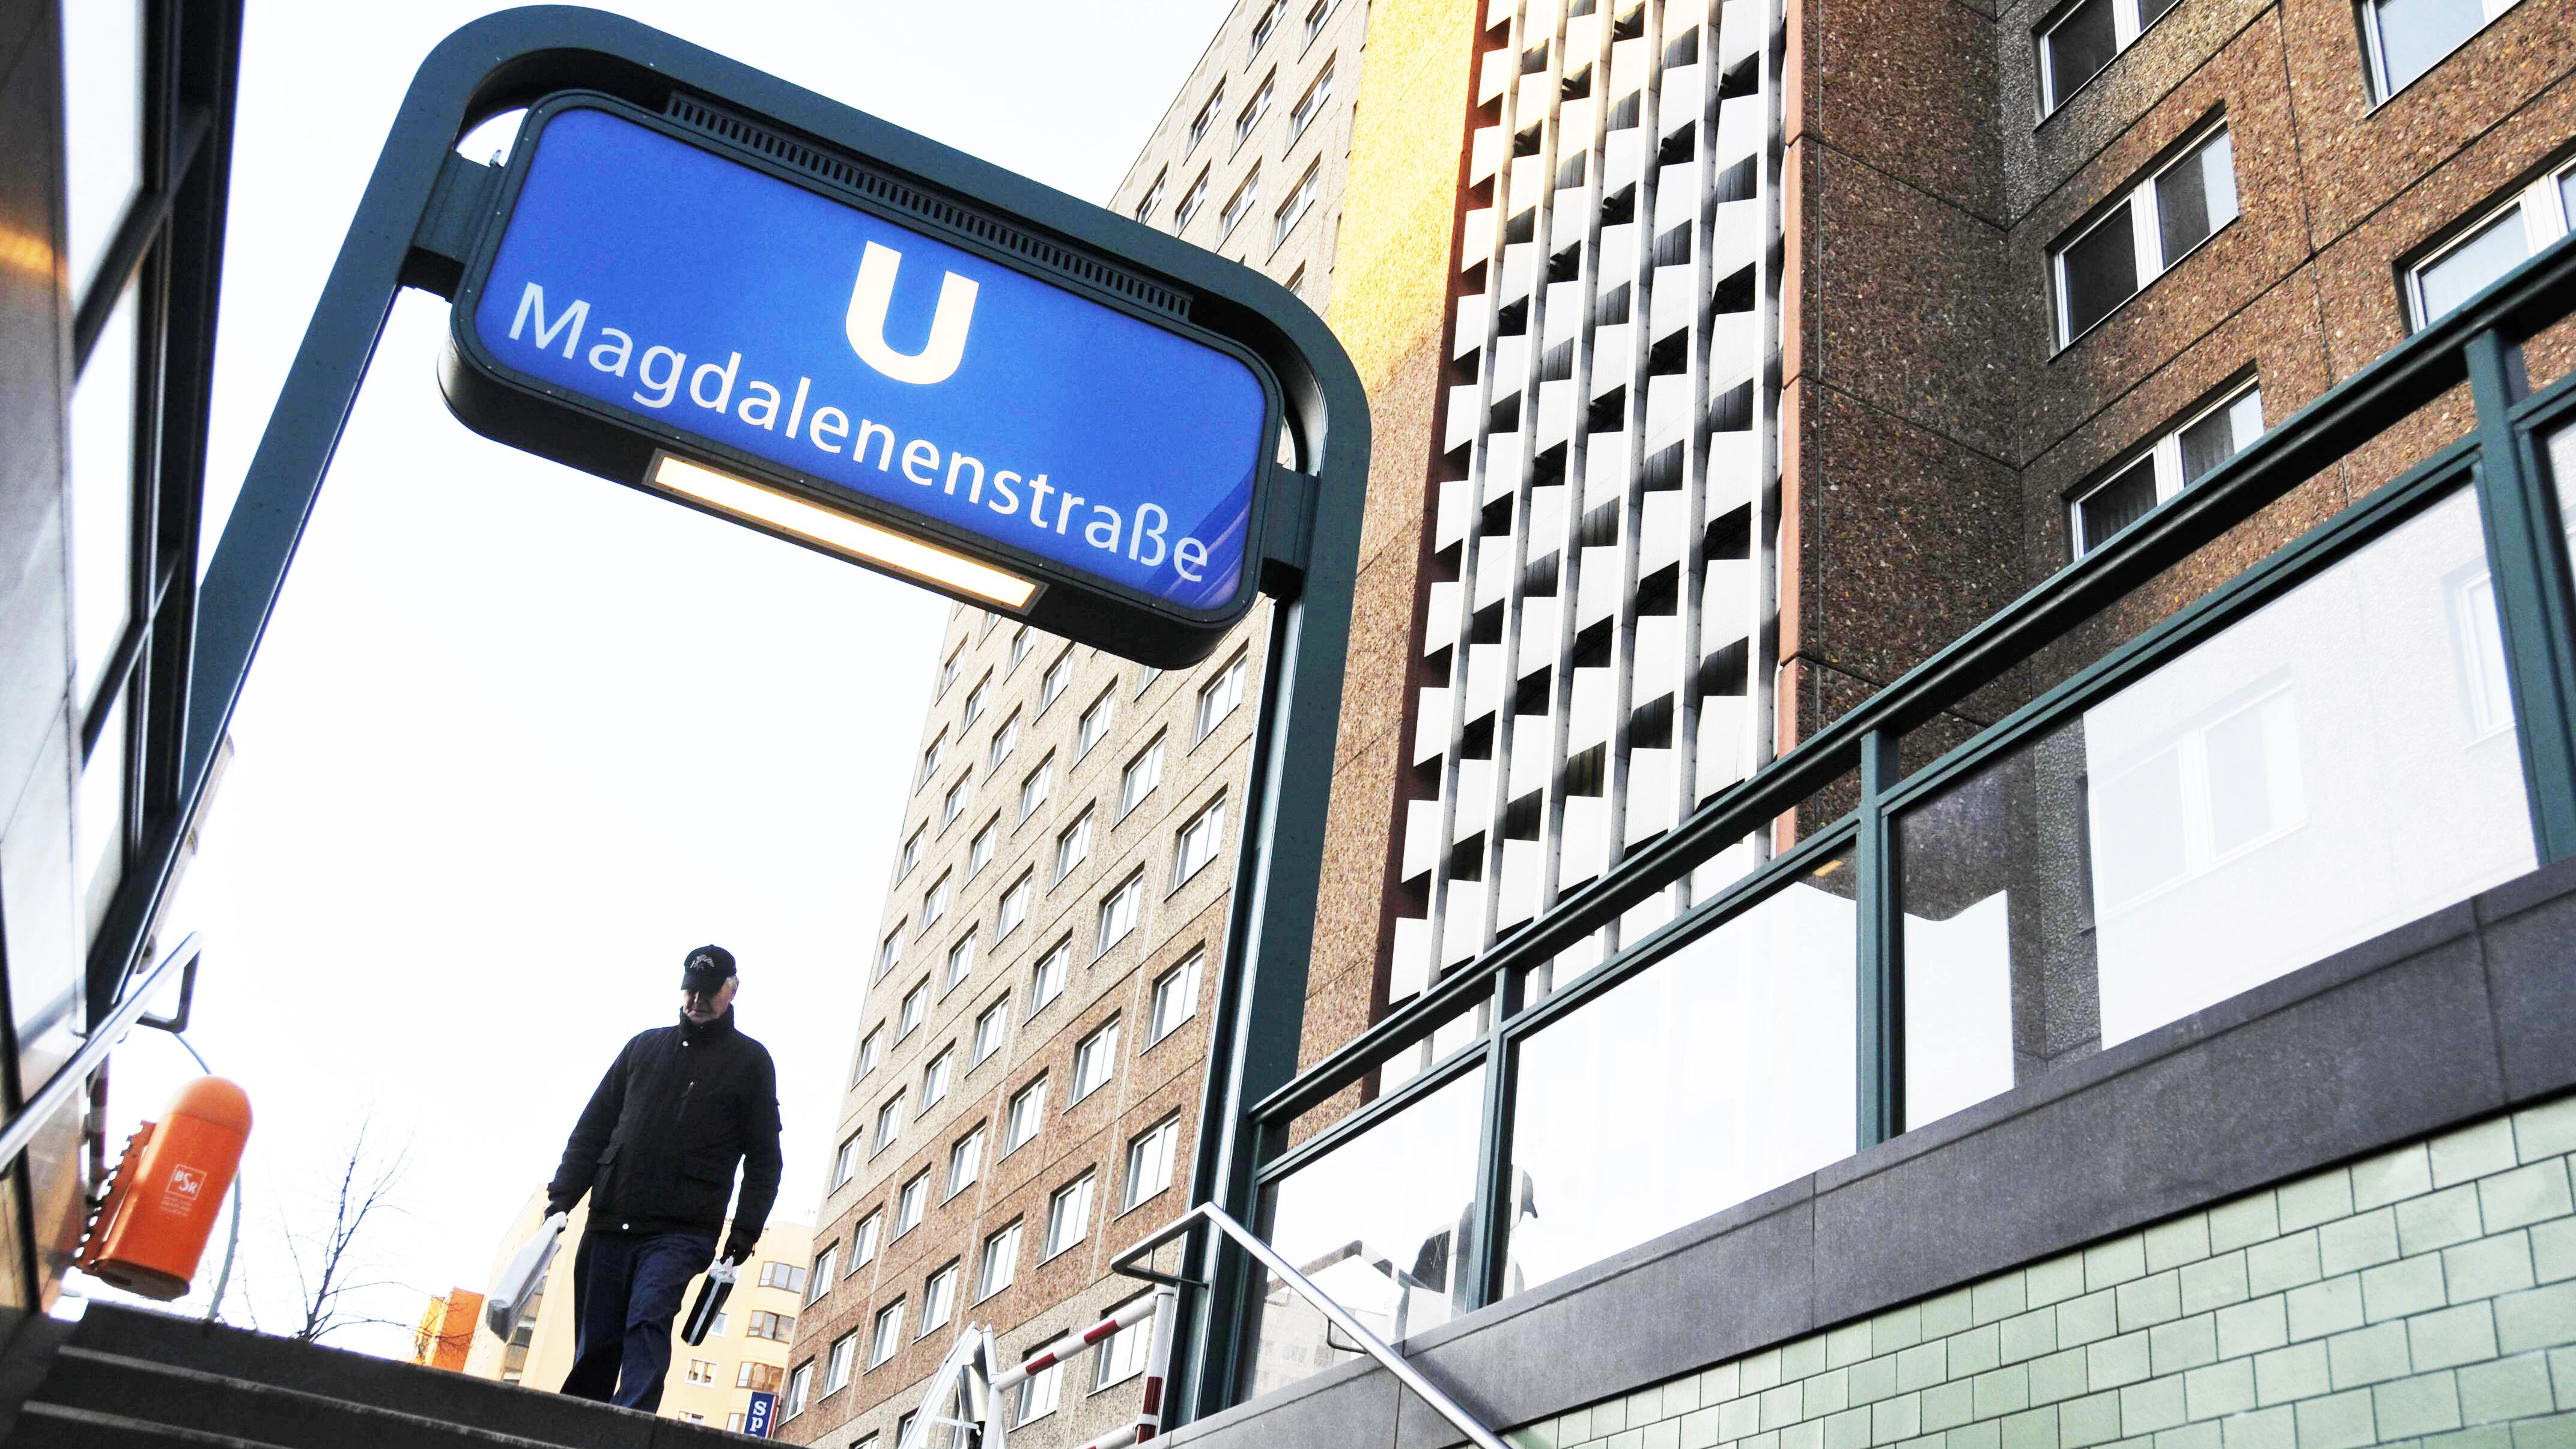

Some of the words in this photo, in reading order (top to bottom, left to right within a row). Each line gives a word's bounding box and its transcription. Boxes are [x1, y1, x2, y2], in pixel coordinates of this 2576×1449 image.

[846, 240, 979, 385] U
[509, 282, 1208, 583] Magdalenenstraße
[174, 1170, 198, 1194] BSR
[749, 1400, 767, 1437] Sp
